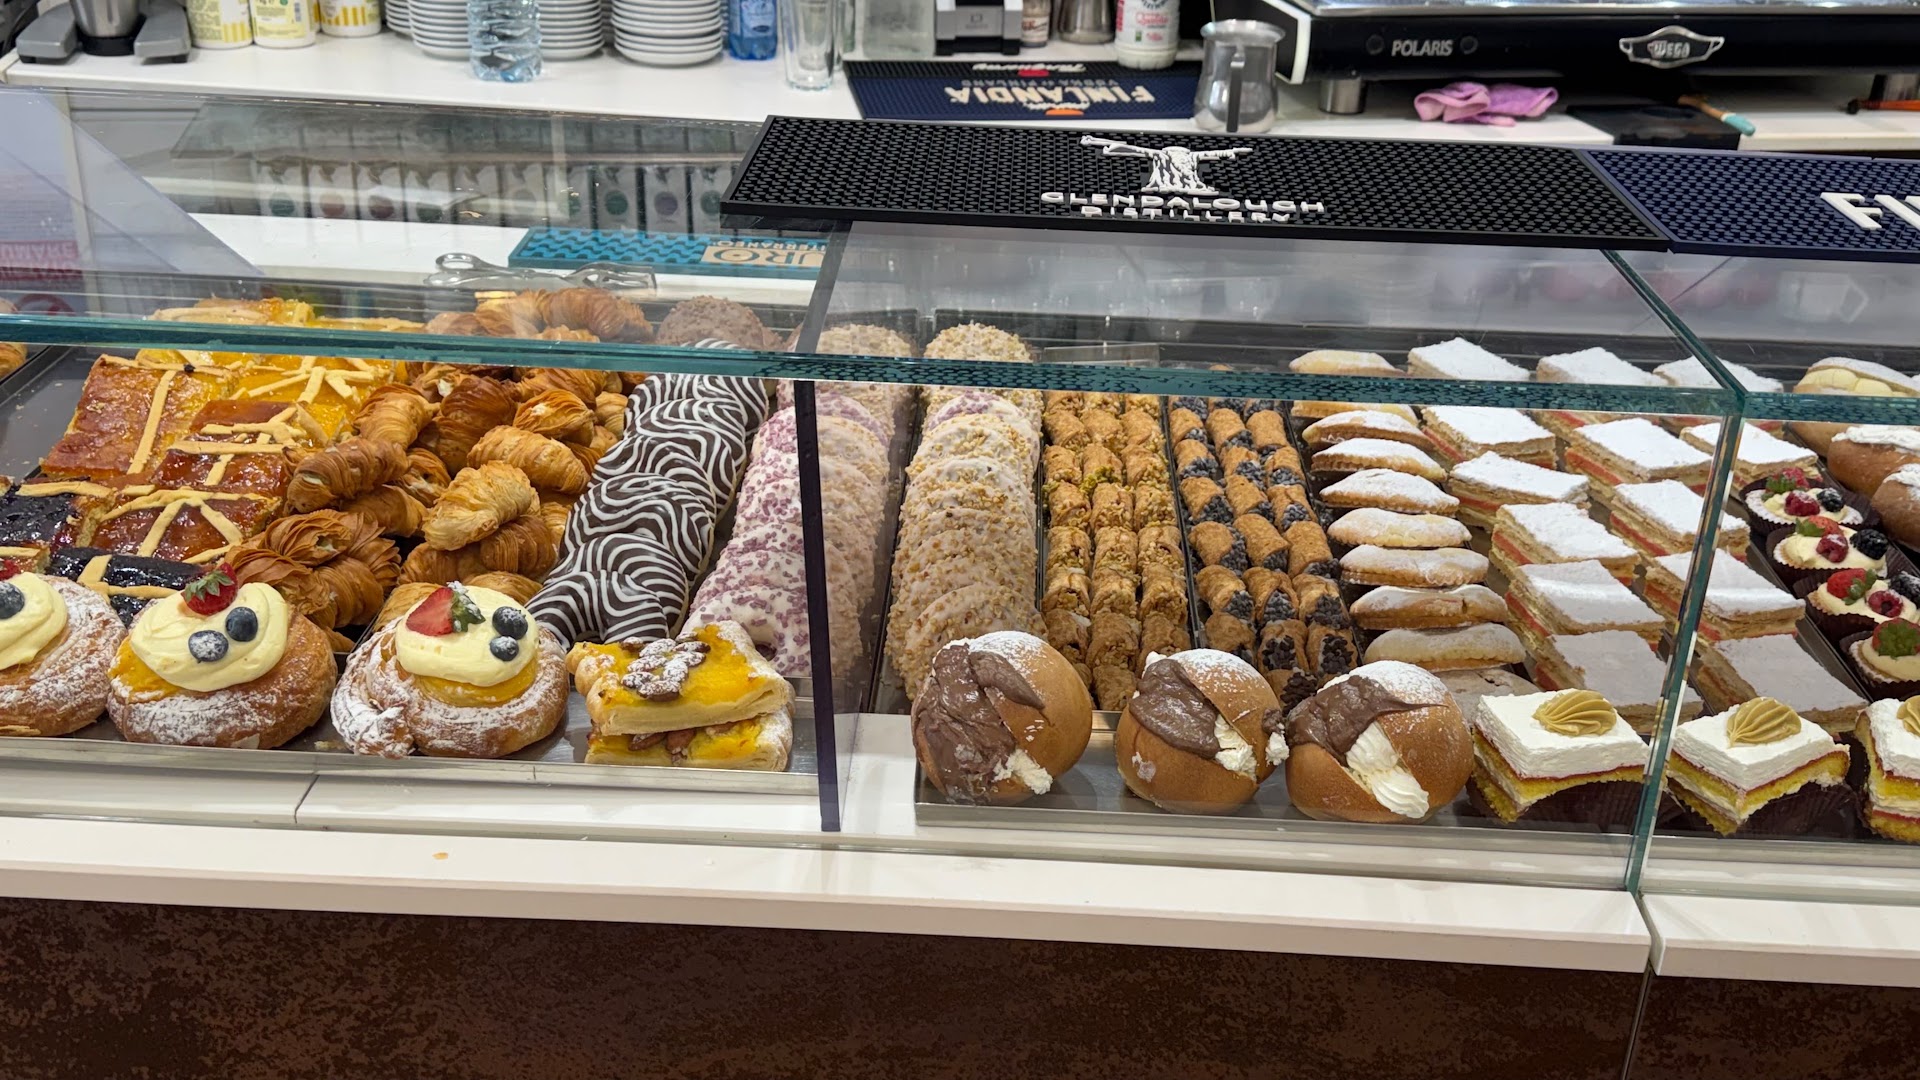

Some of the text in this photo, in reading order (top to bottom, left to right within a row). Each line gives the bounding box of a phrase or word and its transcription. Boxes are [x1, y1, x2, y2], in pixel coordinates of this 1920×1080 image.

[1391, 39, 1454, 57] POLARIS
[1647, 40, 1691, 59] WEGA
[944, 86, 1156, 104] FINLANDIA
[1041, 191, 1325, 213] GLENDALOUGH
[1081, 205, 1291, 223] DISTILLERY
[1820, 192, 1920, 231] FI
